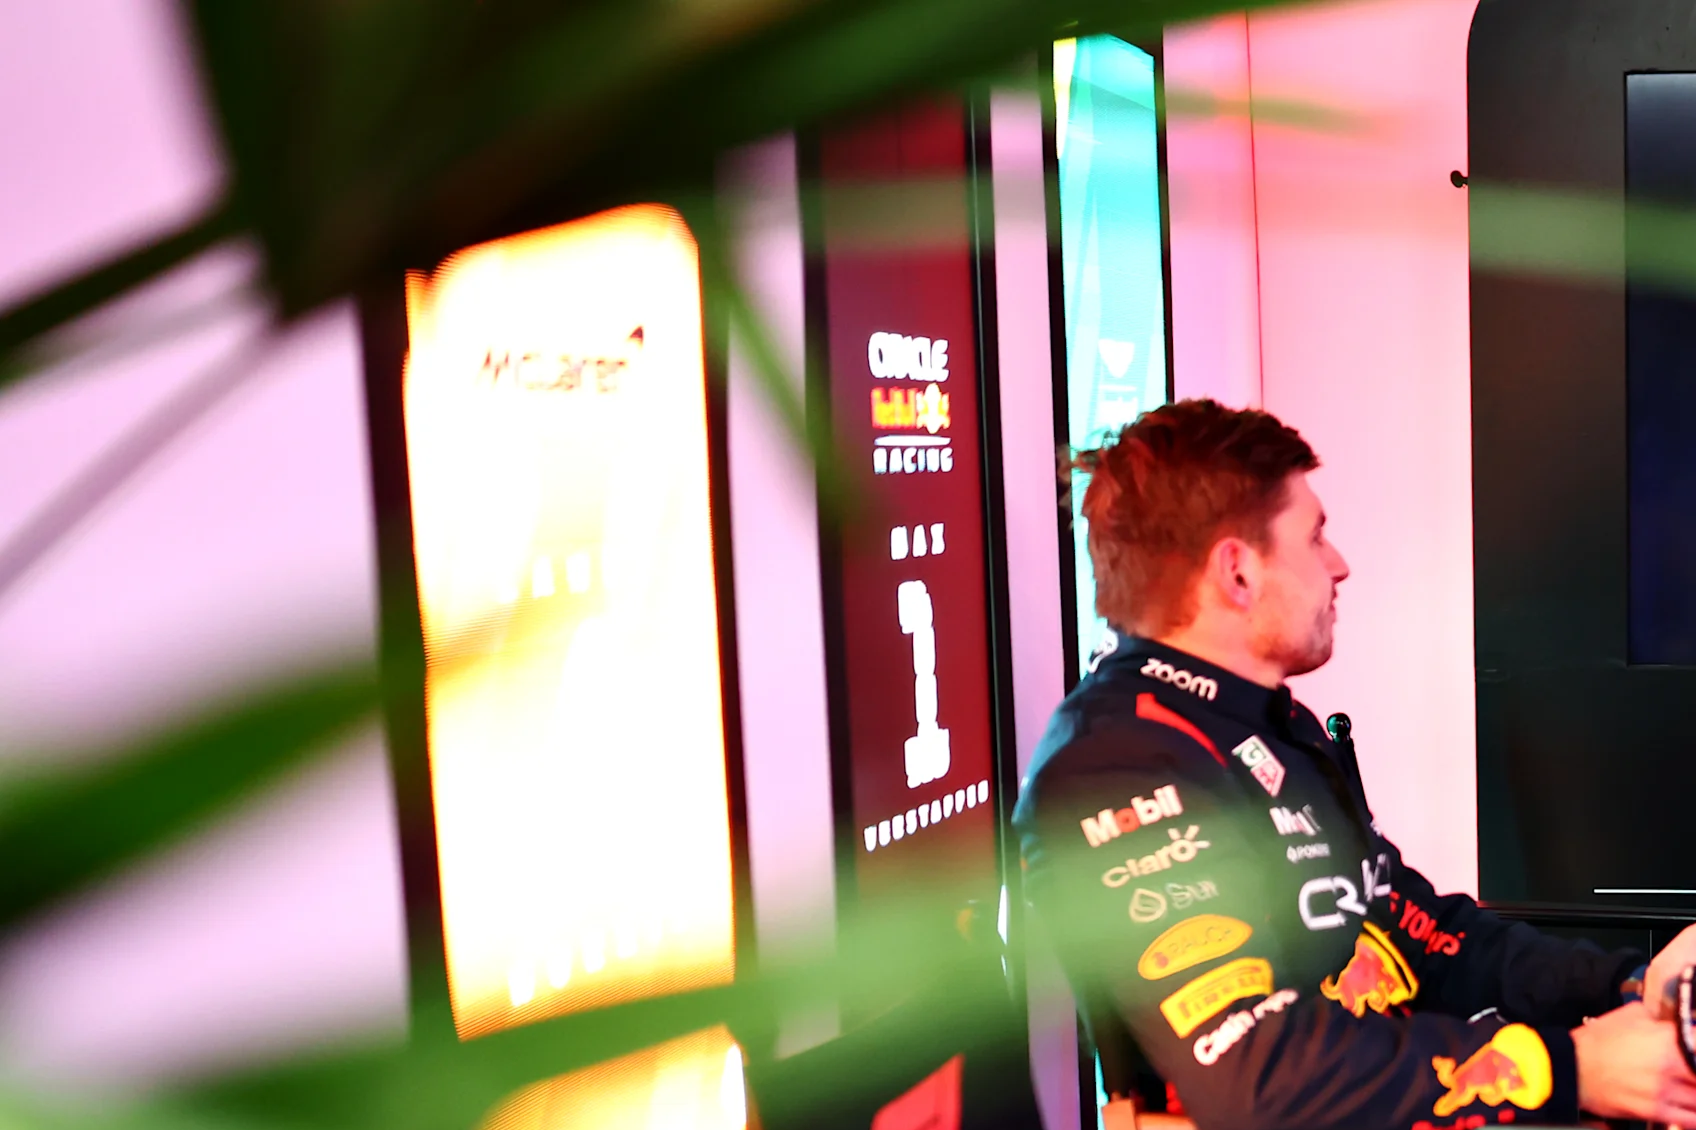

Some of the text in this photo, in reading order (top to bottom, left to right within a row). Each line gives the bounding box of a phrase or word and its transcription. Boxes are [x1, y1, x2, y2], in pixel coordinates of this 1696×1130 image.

[873, 447, 953, 474] RACING
[1140, 657, 1219, 701] zoom
[1080, 784, 1184, 848] Mobil
